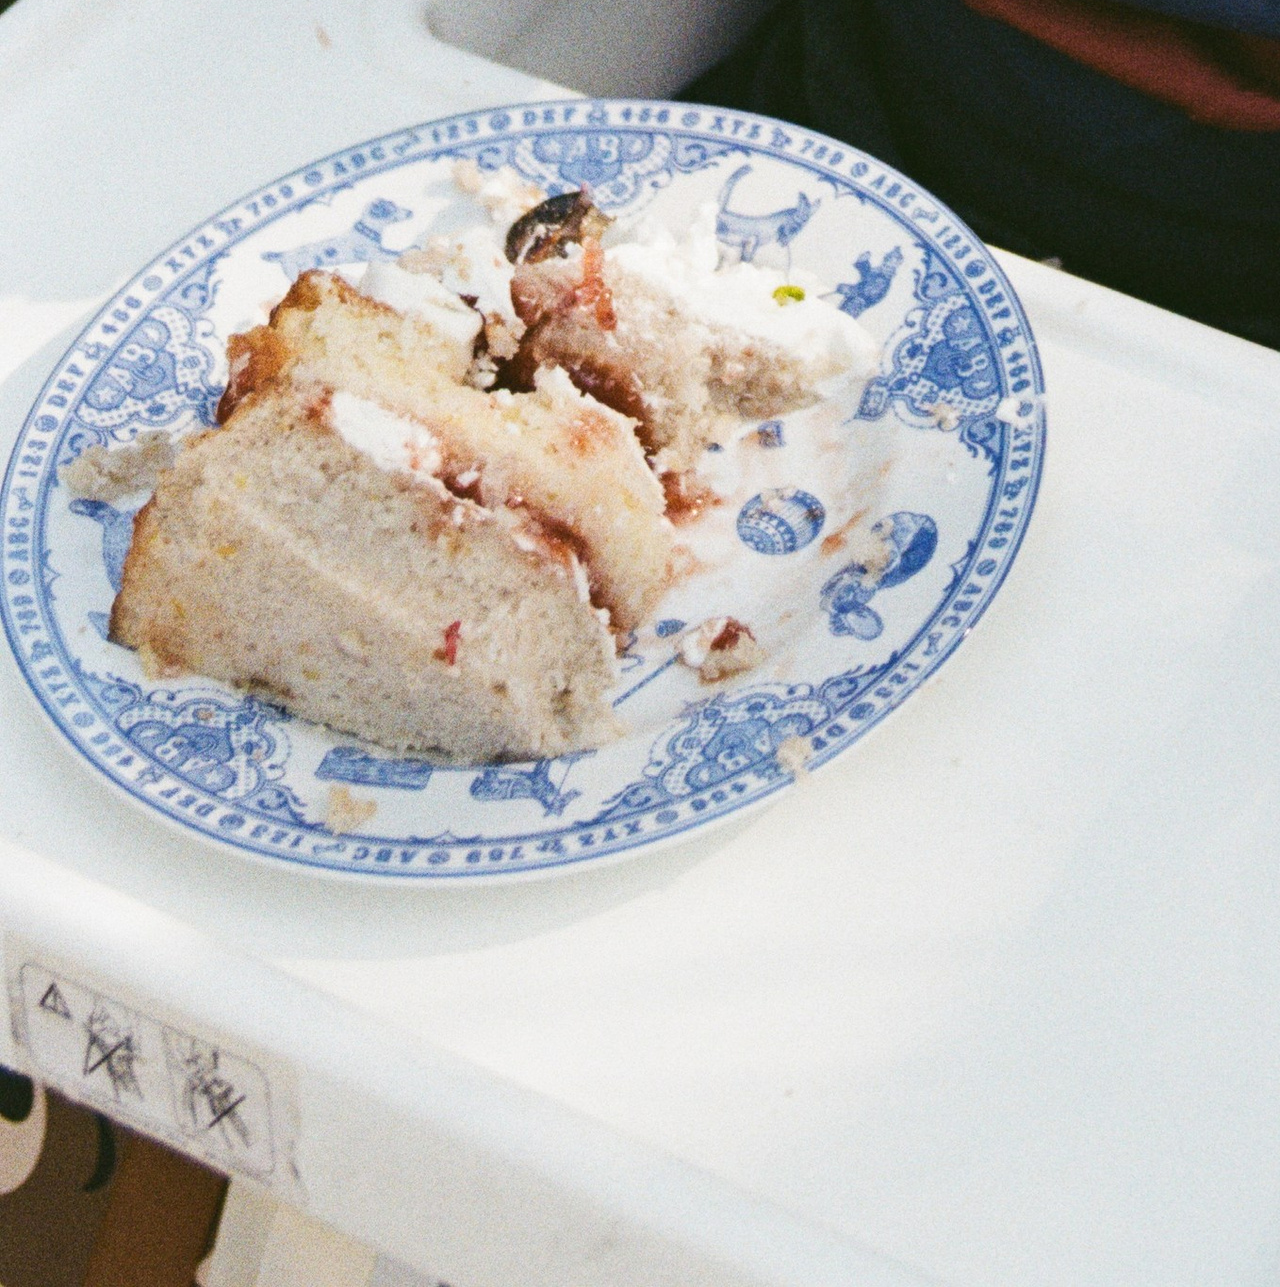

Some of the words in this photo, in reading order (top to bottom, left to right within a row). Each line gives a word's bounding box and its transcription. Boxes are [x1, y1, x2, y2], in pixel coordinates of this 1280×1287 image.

[432, 119, 478, 143] 123
[523, 107, 576, 126] DEF
[333, 146, 386, 176] ABC
[870, 175, 916, 208] ABC
[935, 226, 972, 259] 123
[978, 279, 1011, 320] DEF
[47, 363, 84, 408] DEF
[18, 439, 47, 477] 123
[7, 517, 30, 562] ABC
[941, 583, 982, 627] ABC
[874, 662, 920, 698] 123
